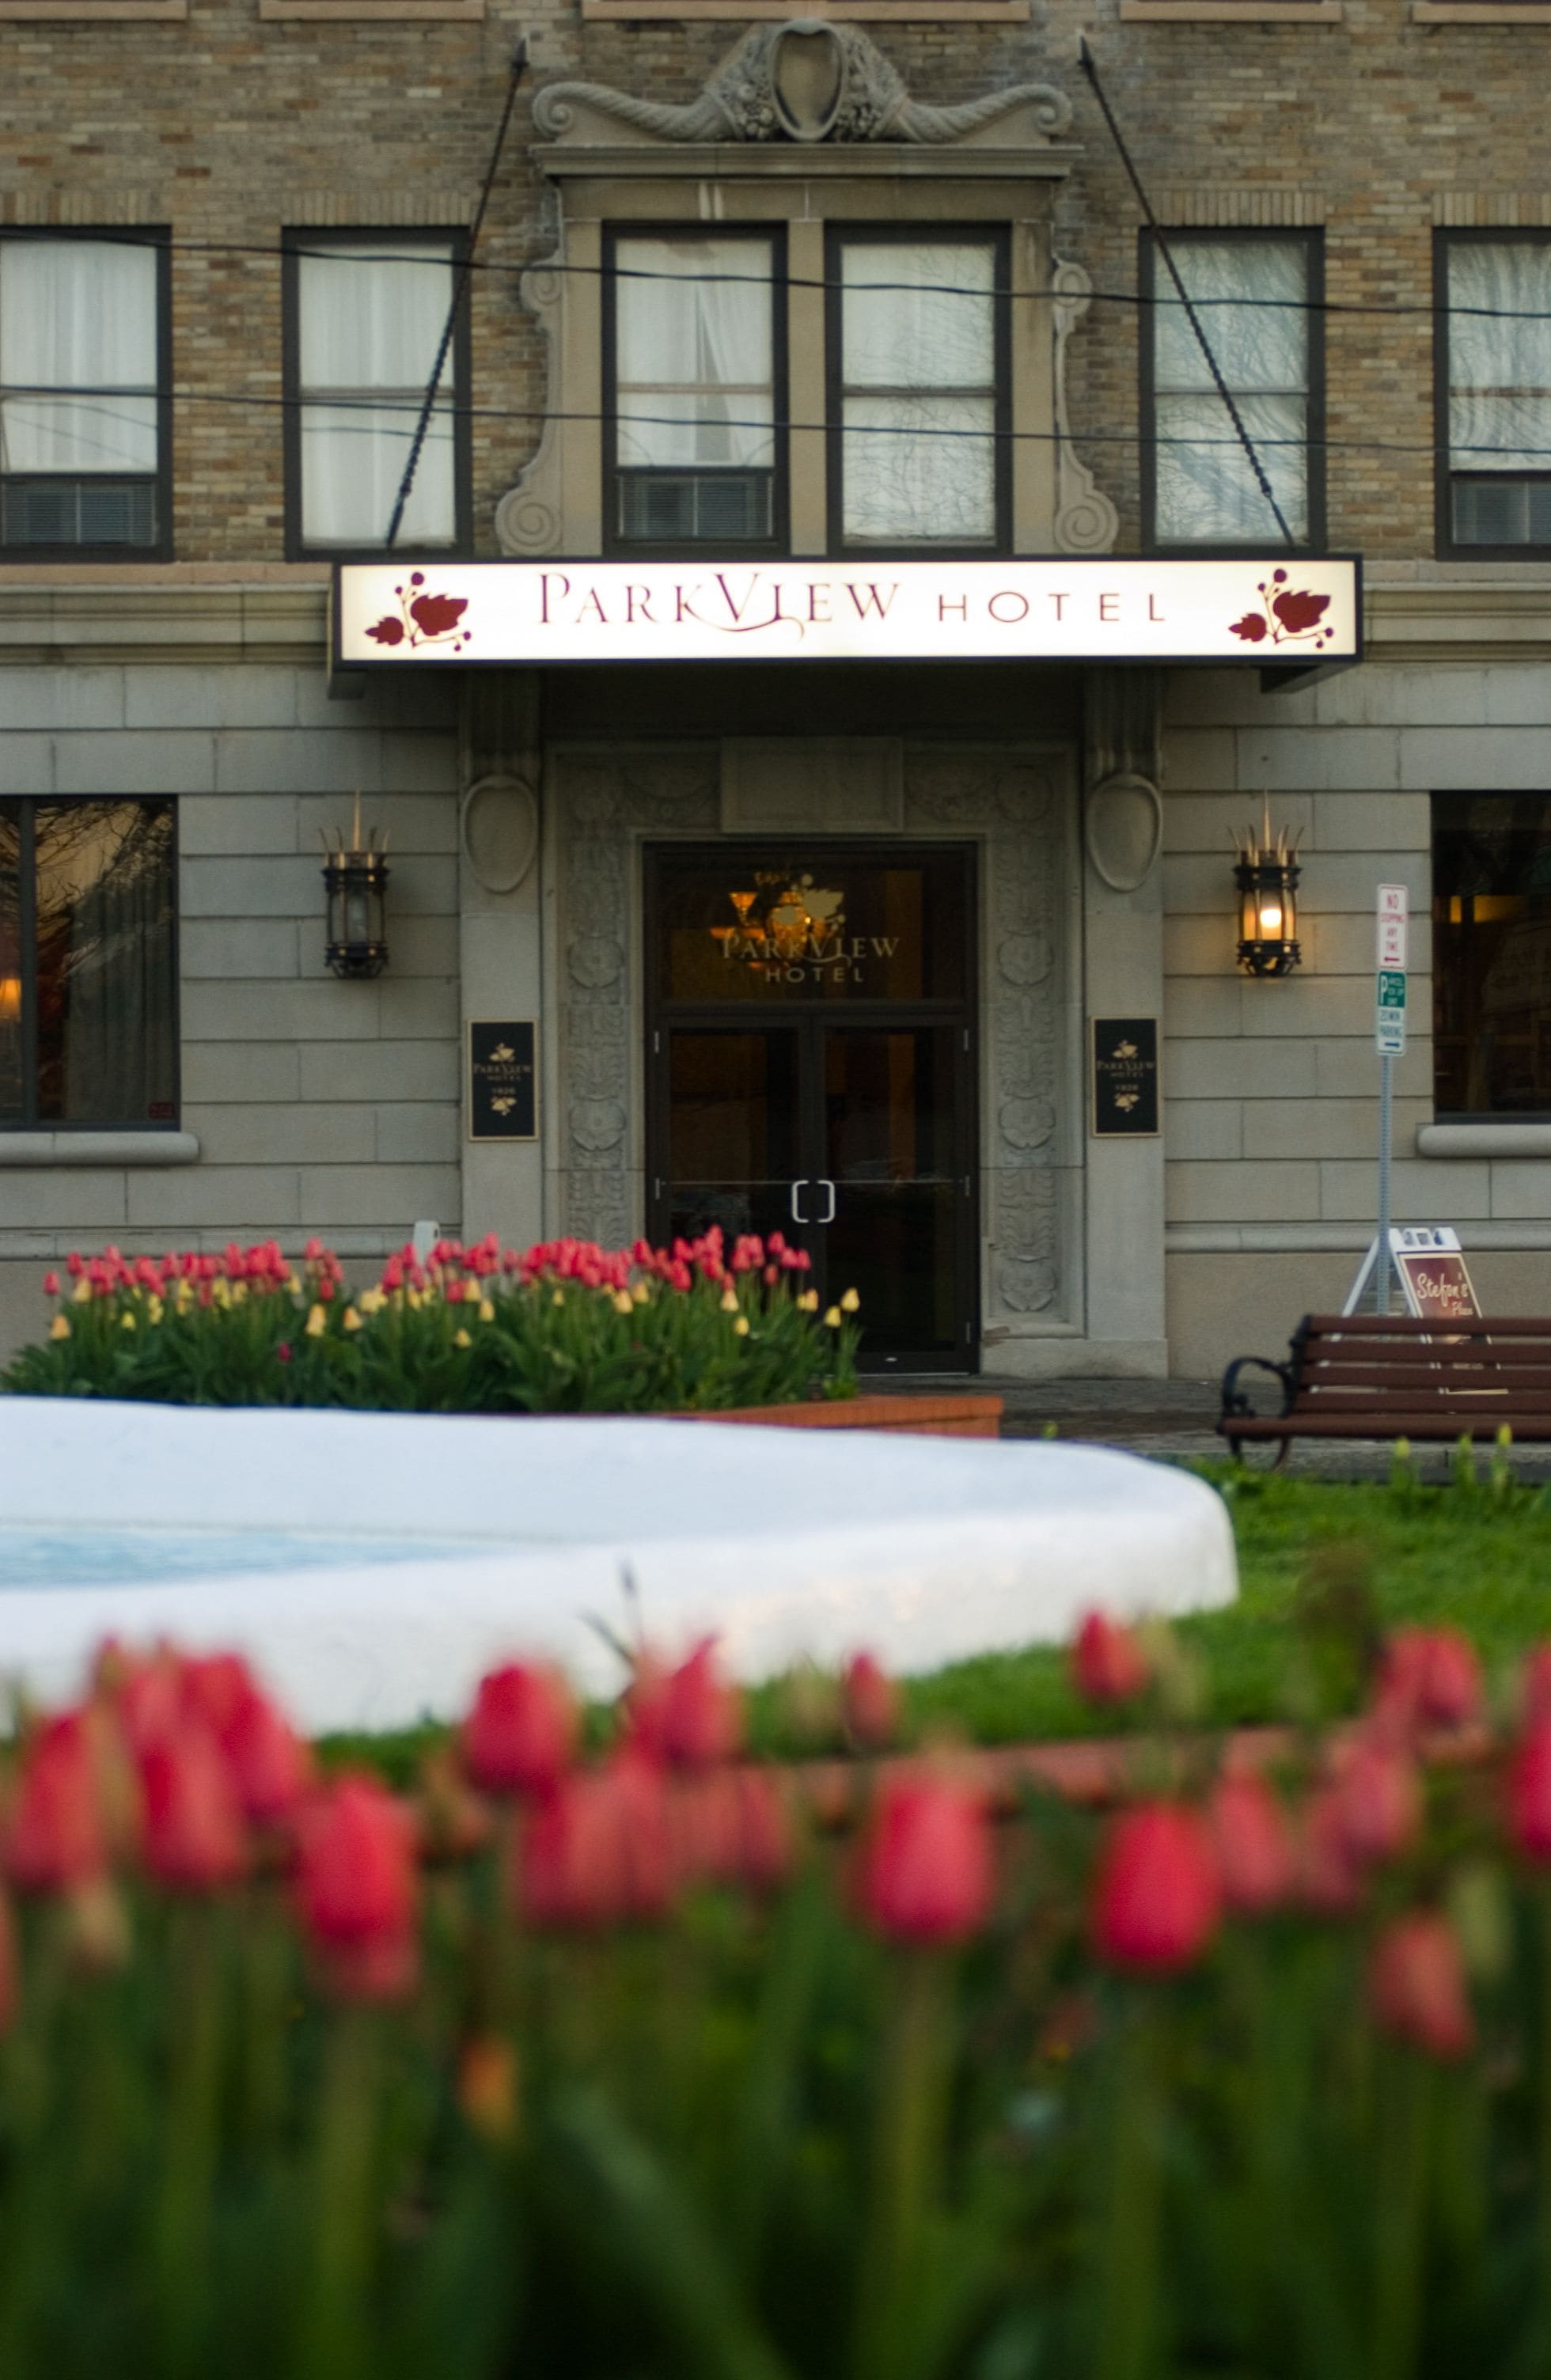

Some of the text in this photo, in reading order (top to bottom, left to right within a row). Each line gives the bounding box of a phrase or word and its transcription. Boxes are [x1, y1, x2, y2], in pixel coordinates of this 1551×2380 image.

[538, 572, 1166, 639] PARKVIEW HOTEL
[1386, 894, 1399, 909] NO
[722, 935, 900, 968] PARKVIEW
[765, 967, 863, 982] HOTEL
